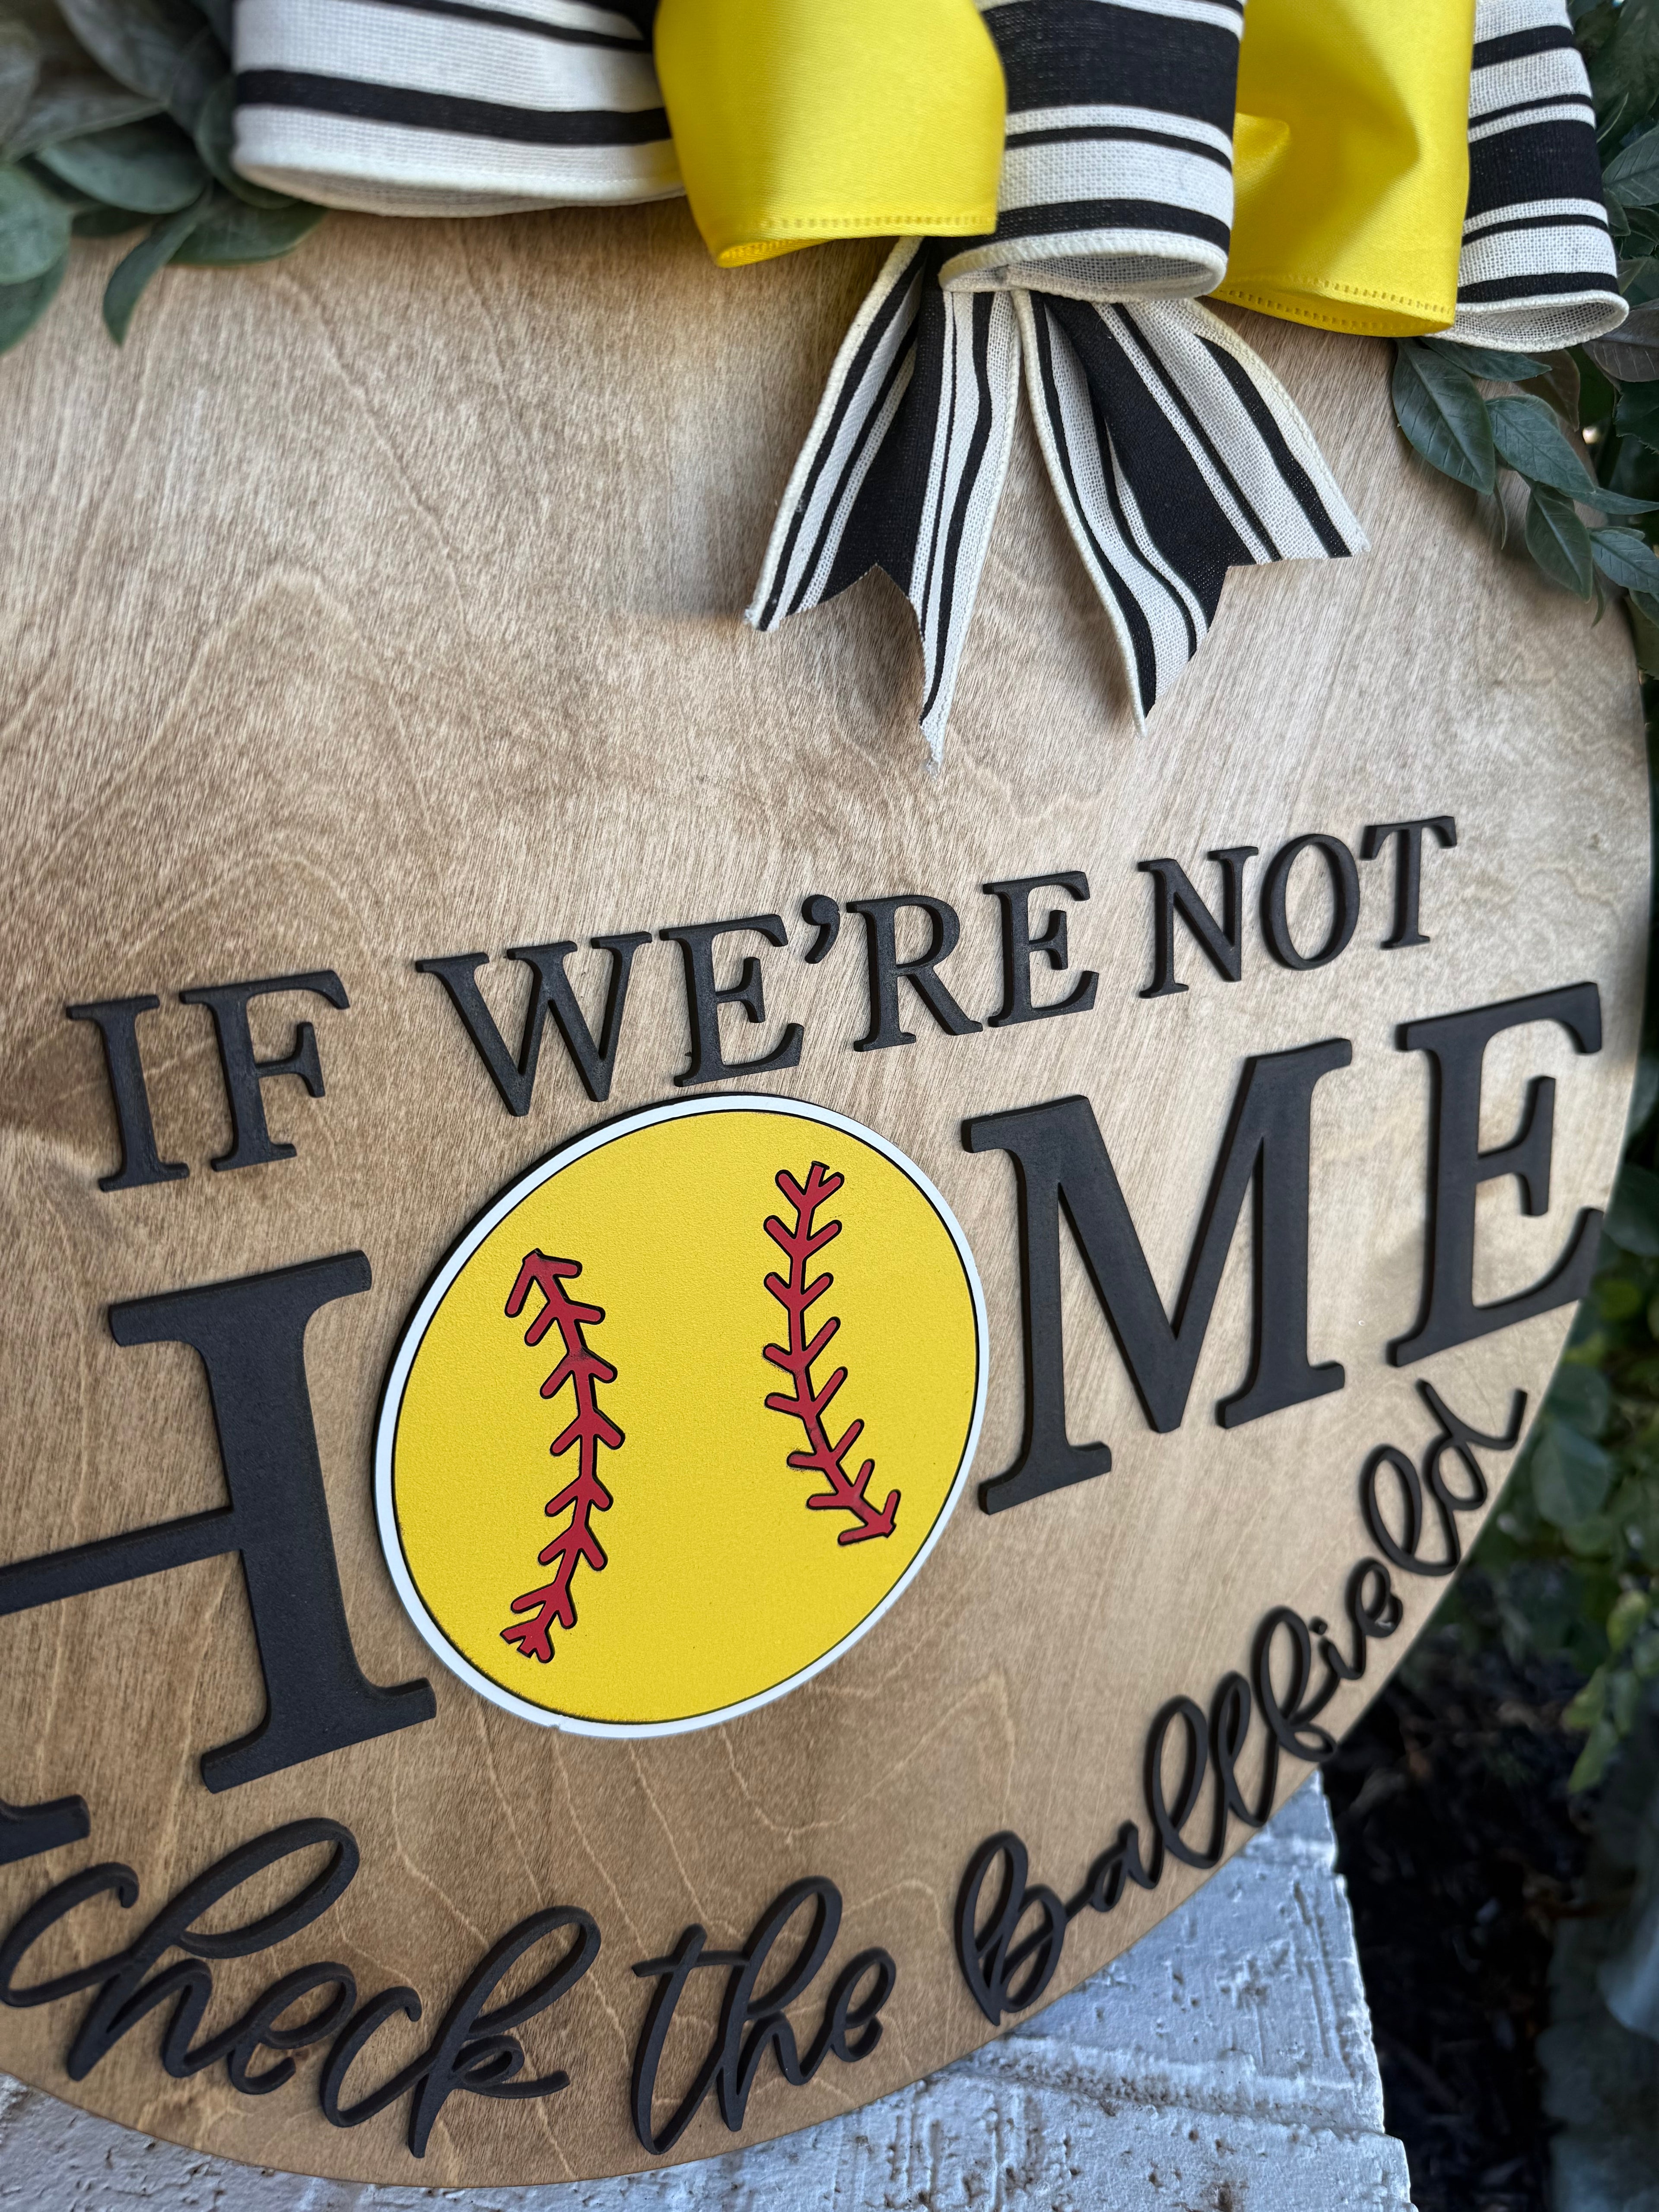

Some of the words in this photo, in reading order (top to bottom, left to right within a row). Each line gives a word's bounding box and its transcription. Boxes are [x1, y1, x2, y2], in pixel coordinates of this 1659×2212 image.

[66, 970, 350, 1192] IF
[1138, 814, 1457, 1000] NOT
[632, 1875, 897, 2156] the
[954, 1378, 1529, 2027] Ballfield
